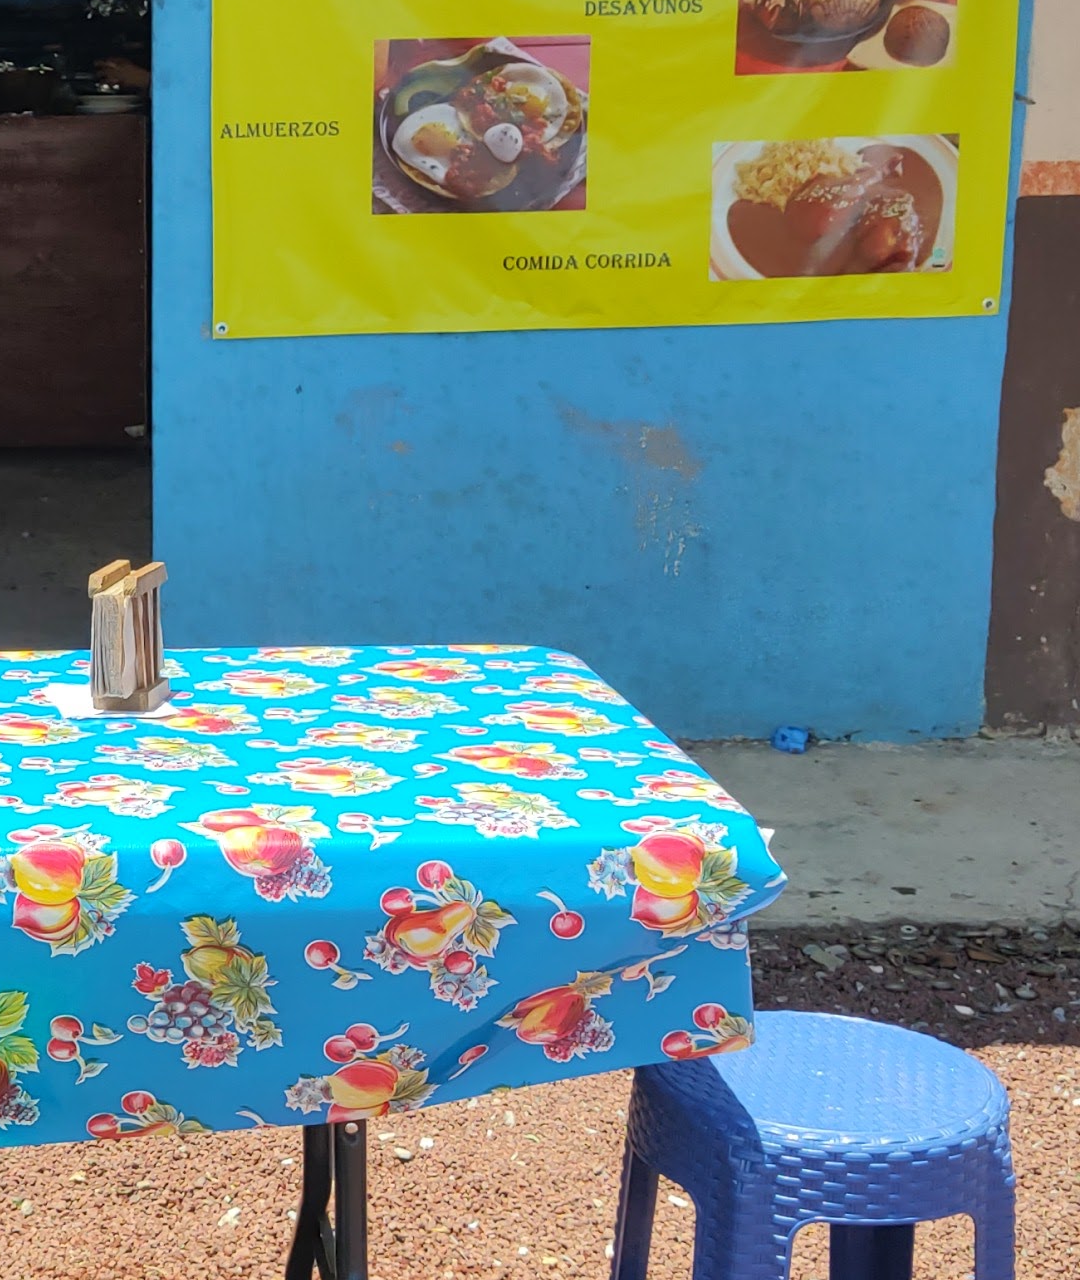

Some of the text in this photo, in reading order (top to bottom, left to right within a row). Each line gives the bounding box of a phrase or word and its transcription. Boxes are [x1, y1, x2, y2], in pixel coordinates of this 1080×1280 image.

[219, 119, 340, 140] ALMUERZOS
[501, 251, 672, 272] COMIDA CORRIDA
